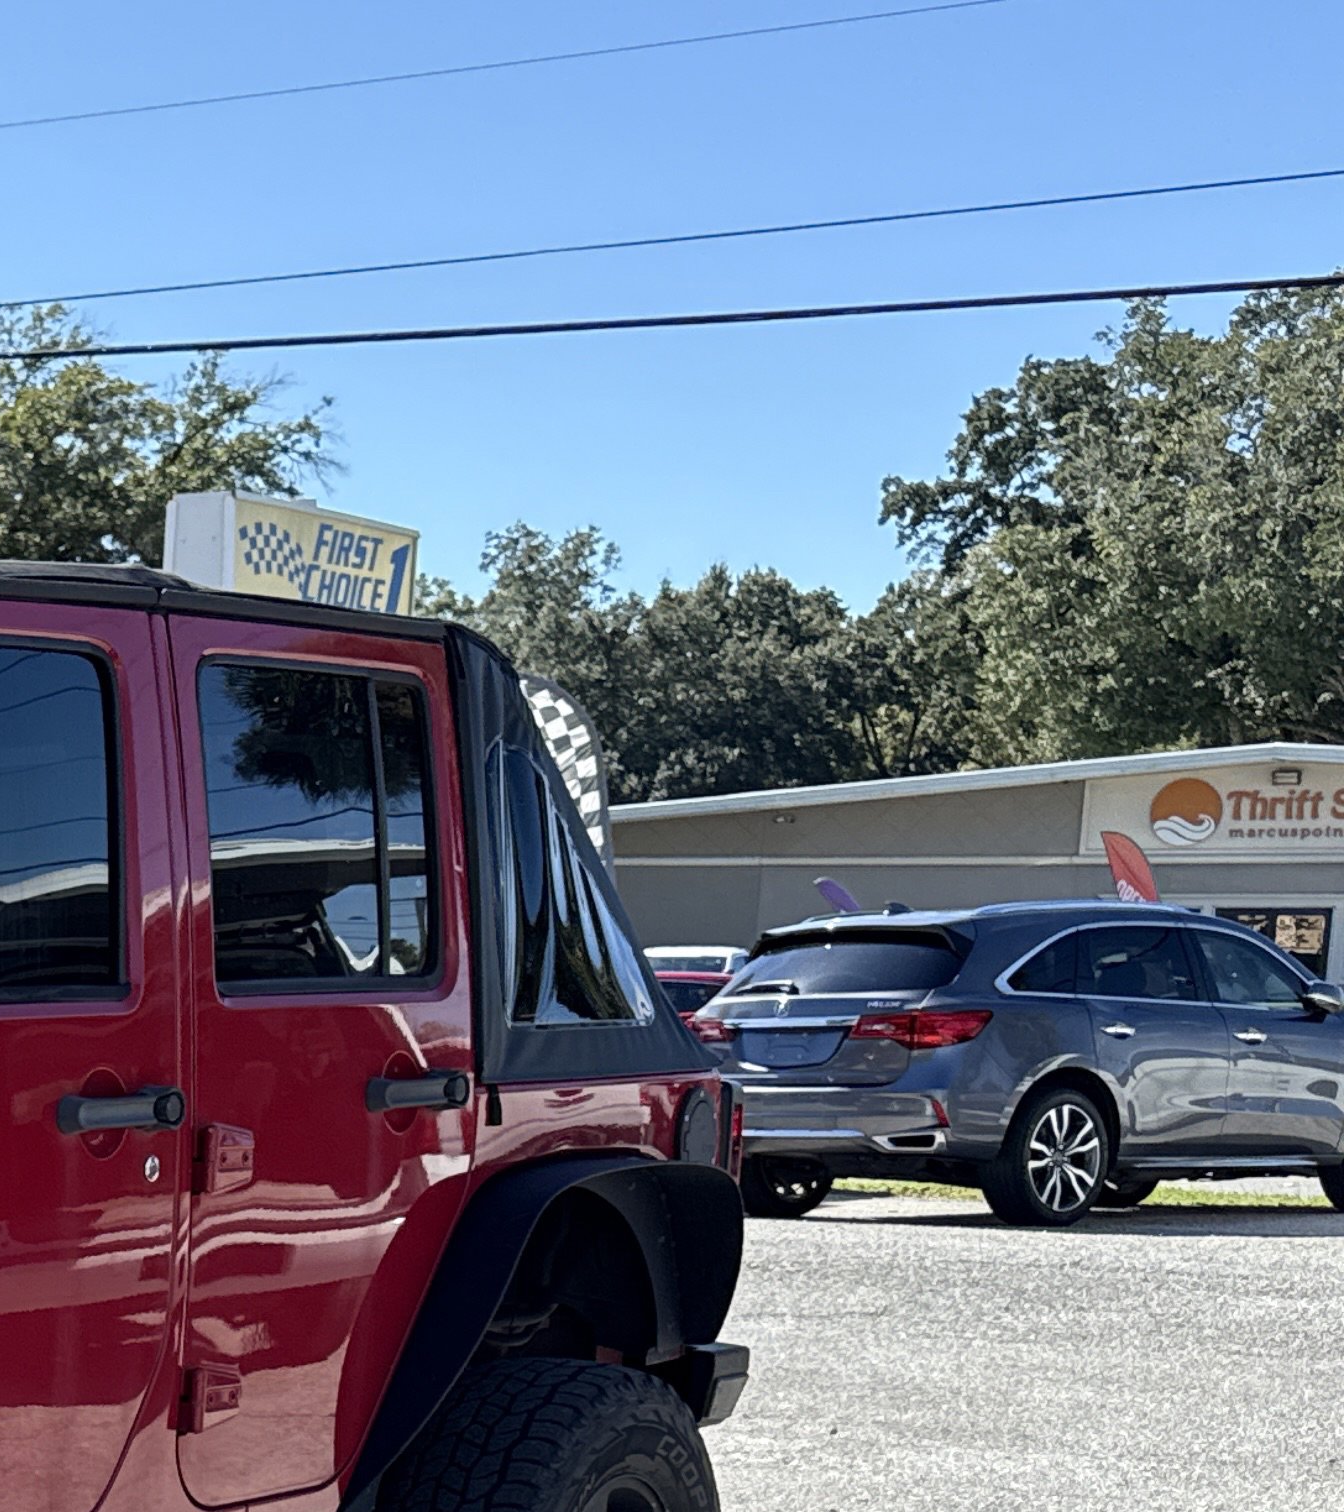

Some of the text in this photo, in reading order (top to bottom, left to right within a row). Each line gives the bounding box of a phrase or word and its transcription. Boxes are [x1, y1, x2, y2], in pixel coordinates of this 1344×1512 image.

[313, 522, 384, 571] FIRST
[302, 563, 386, 612] CHOICE
[385, 543, 411, 614] 1
[1227, 789, 1324, 821] Thrift
